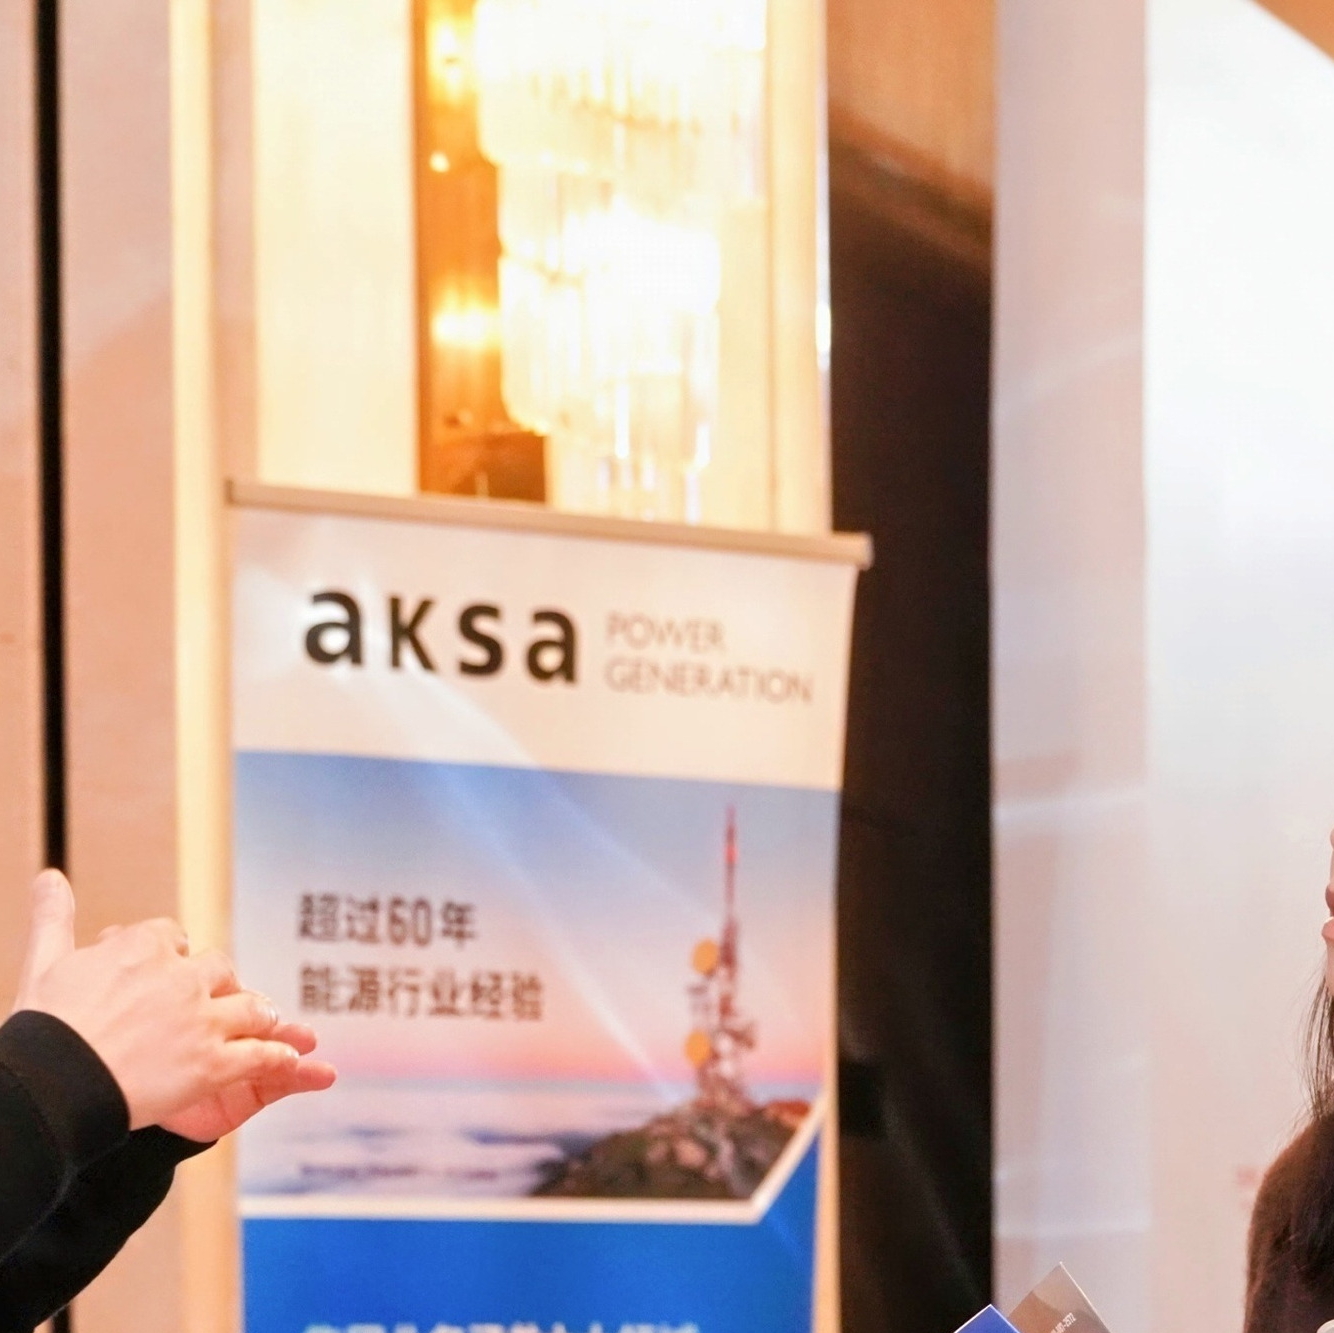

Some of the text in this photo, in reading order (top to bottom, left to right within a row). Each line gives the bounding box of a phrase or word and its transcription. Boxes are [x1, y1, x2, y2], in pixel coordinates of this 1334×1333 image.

[304, 588, 725, 684] aksa POWER
[604, 659, 813, 705] GENERATION
[298, 893, 478, 949] 超过60年
[300, 964, 545, 1022] 能源行业经验
